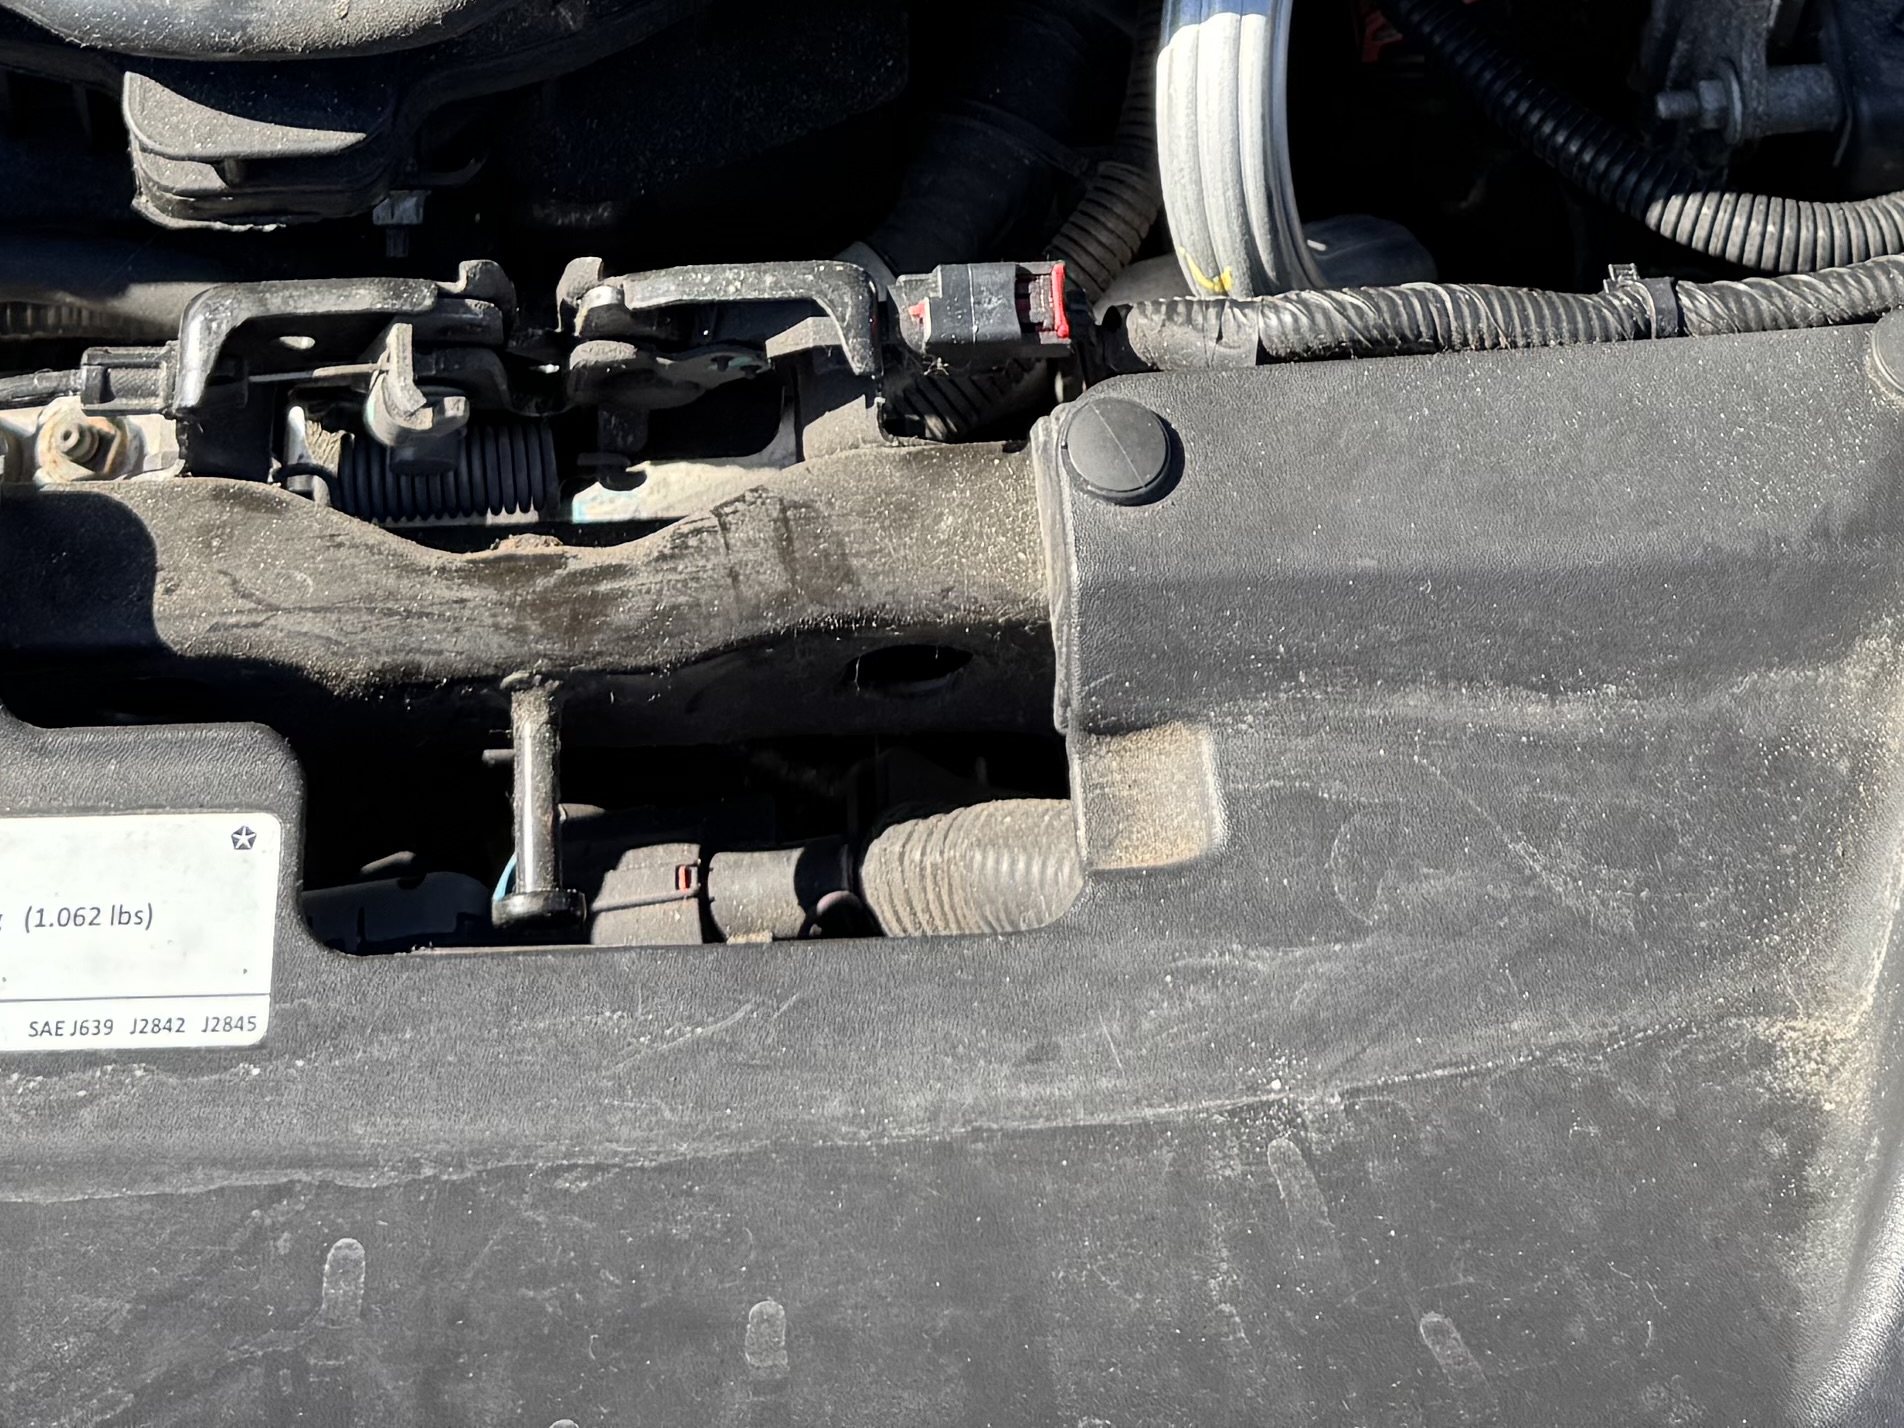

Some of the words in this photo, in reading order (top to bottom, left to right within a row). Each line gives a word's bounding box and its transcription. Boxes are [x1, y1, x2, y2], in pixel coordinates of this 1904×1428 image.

[22, 904, 105, 933] (1.062
[108, 901, 155, 931] lbs)
[27, 1021, 67, 1039] SAE
[68, 1020, 114, 1039] J639
[129, 1017, 187, 1036] J2842
[200, 1015, 259, 1034] J2845
